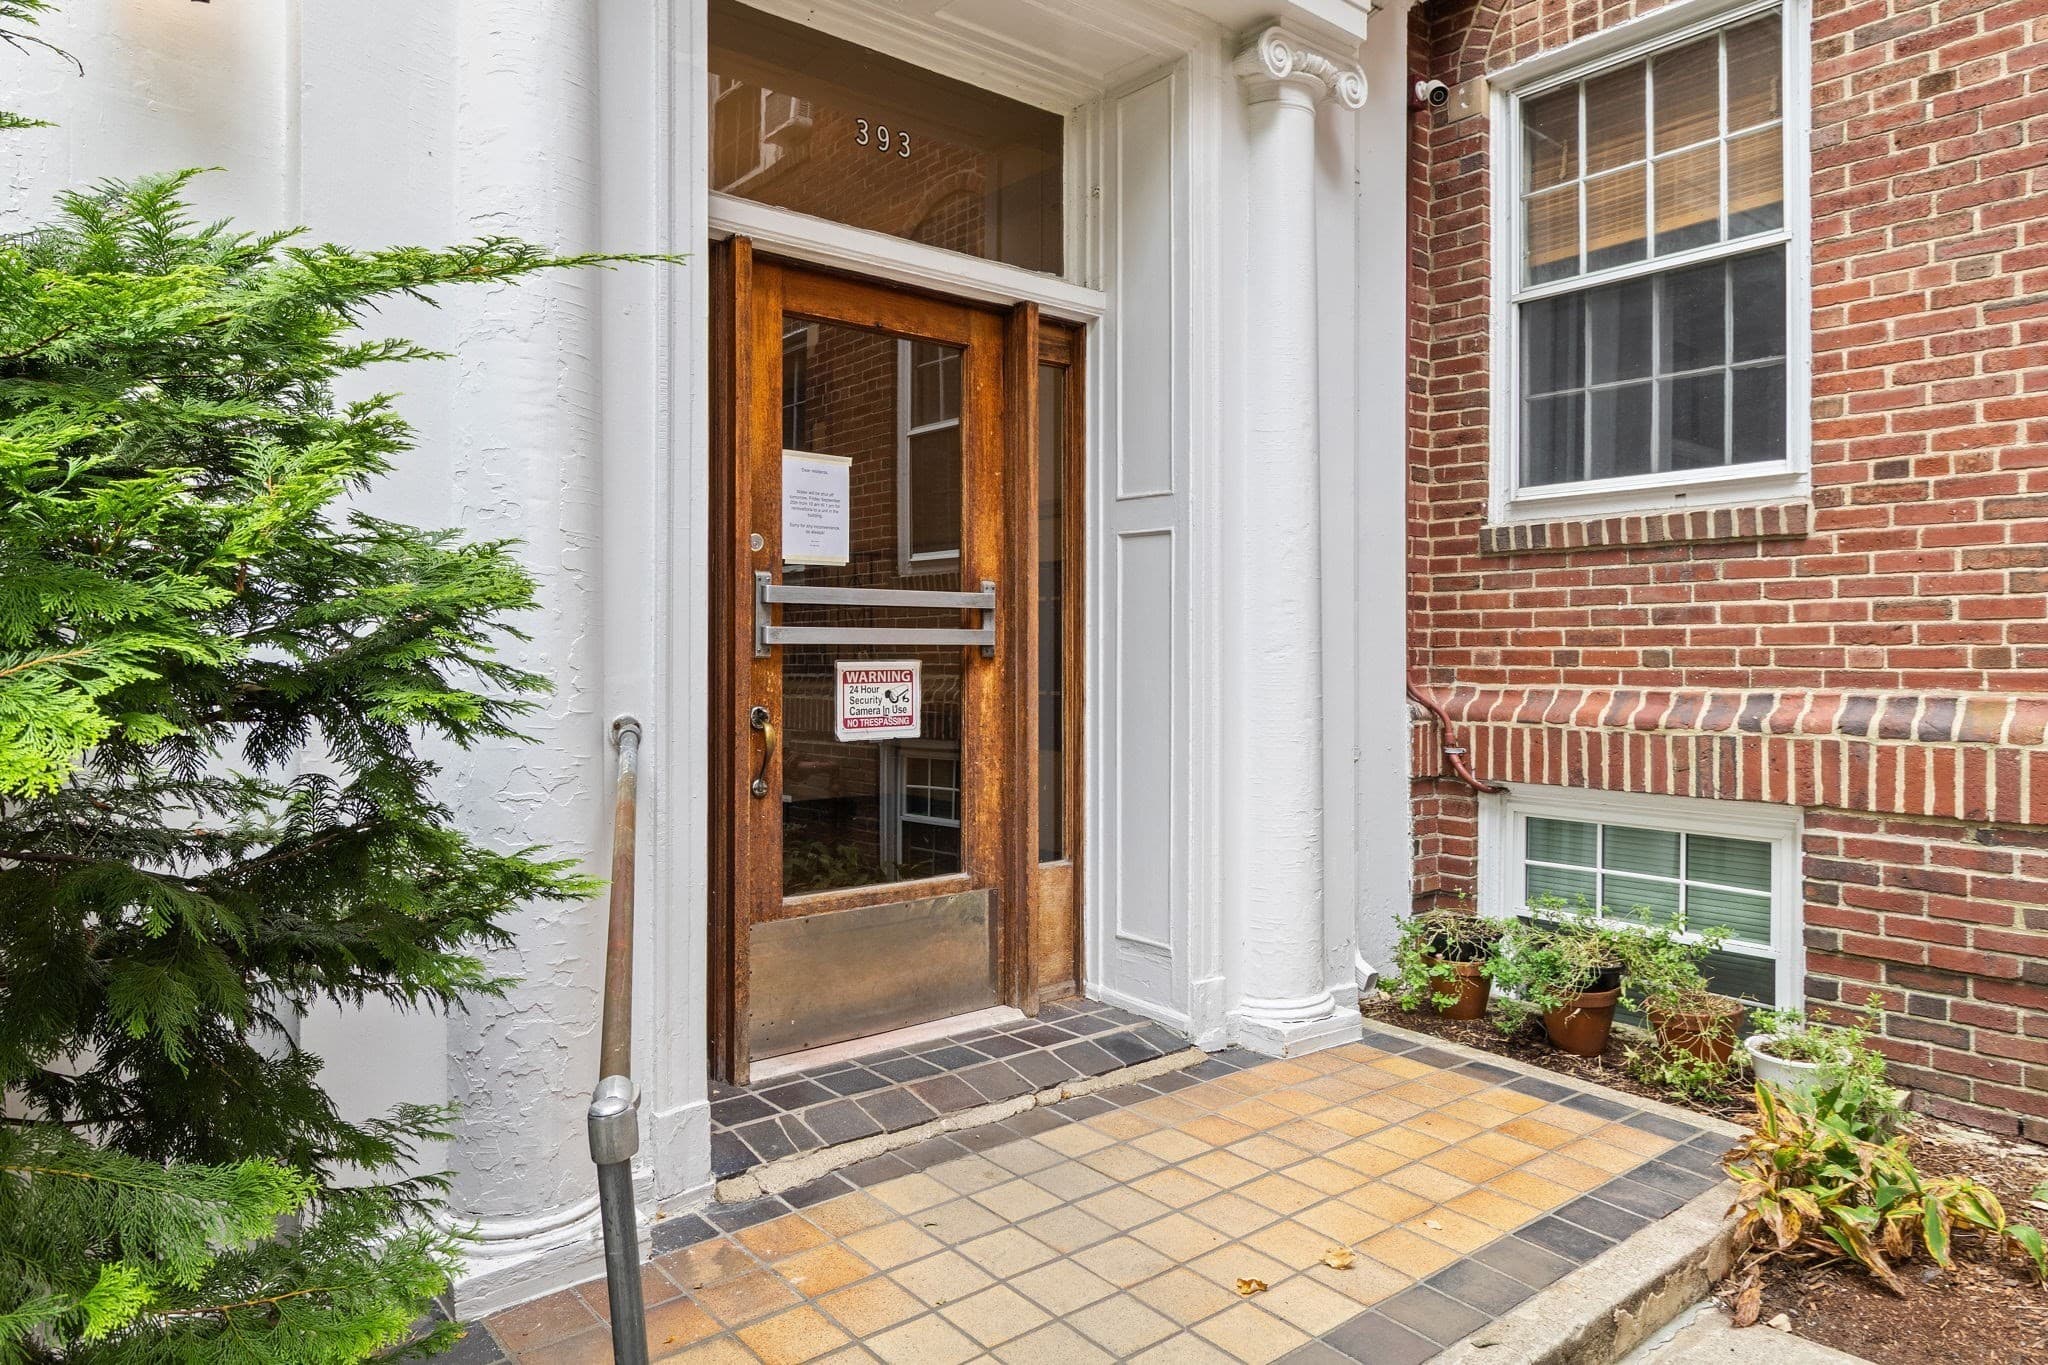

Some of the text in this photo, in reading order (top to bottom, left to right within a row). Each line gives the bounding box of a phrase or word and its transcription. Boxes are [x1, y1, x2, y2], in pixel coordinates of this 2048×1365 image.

[855, 118, 911, 158] 393
[845, 670, 911, 683] WARNING
[849, 685, 880, 694] 24 Hour
[849, 695, 883, 706] Security
[849, 704, 907, 716] Camera In Use
[847, 717, 910, 728] NO TRESPASSING
